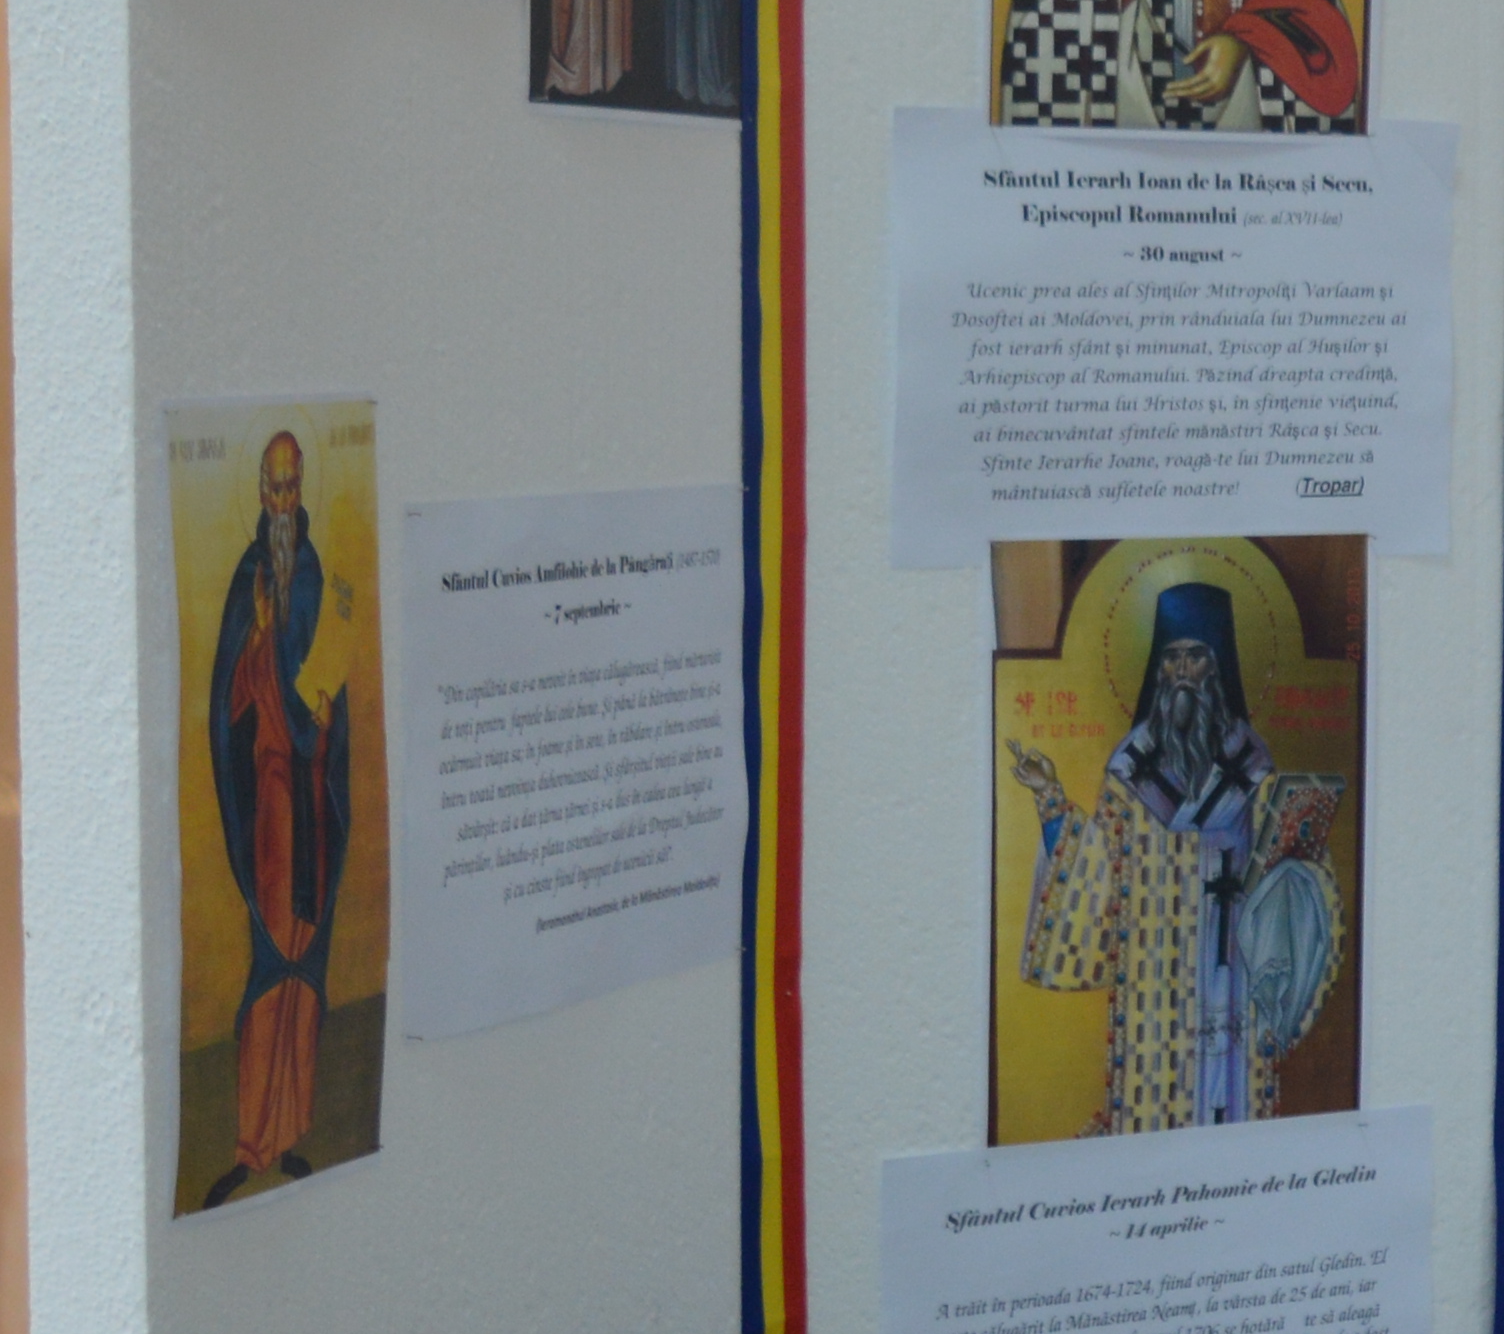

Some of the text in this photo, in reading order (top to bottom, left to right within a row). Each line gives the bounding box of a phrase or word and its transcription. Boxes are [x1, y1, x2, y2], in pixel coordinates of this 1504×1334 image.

[983, 169, 1373, 195] Sfântul Ierarh Ioan de la Râșca și Secu,
[1022, 204, 1121, 227] Episcopul
[1129, 205, 1236, 223] Romanului
[1270, 209, 1283, 225] al
[1140, 245, 1224, 264] 30 august
[1295, 476, 1365, 498] (Tropar)
[945, 1165, 1376, 1233] Sfântul Cuvios Ierarh Pahomie de la Gledin
[1125, 1215, 1209, 1239] 14 aprilie
[935, 1246, 1390, 1320] A trăit în perioada 1674-1724, fiind originar din satul Gledin. El
